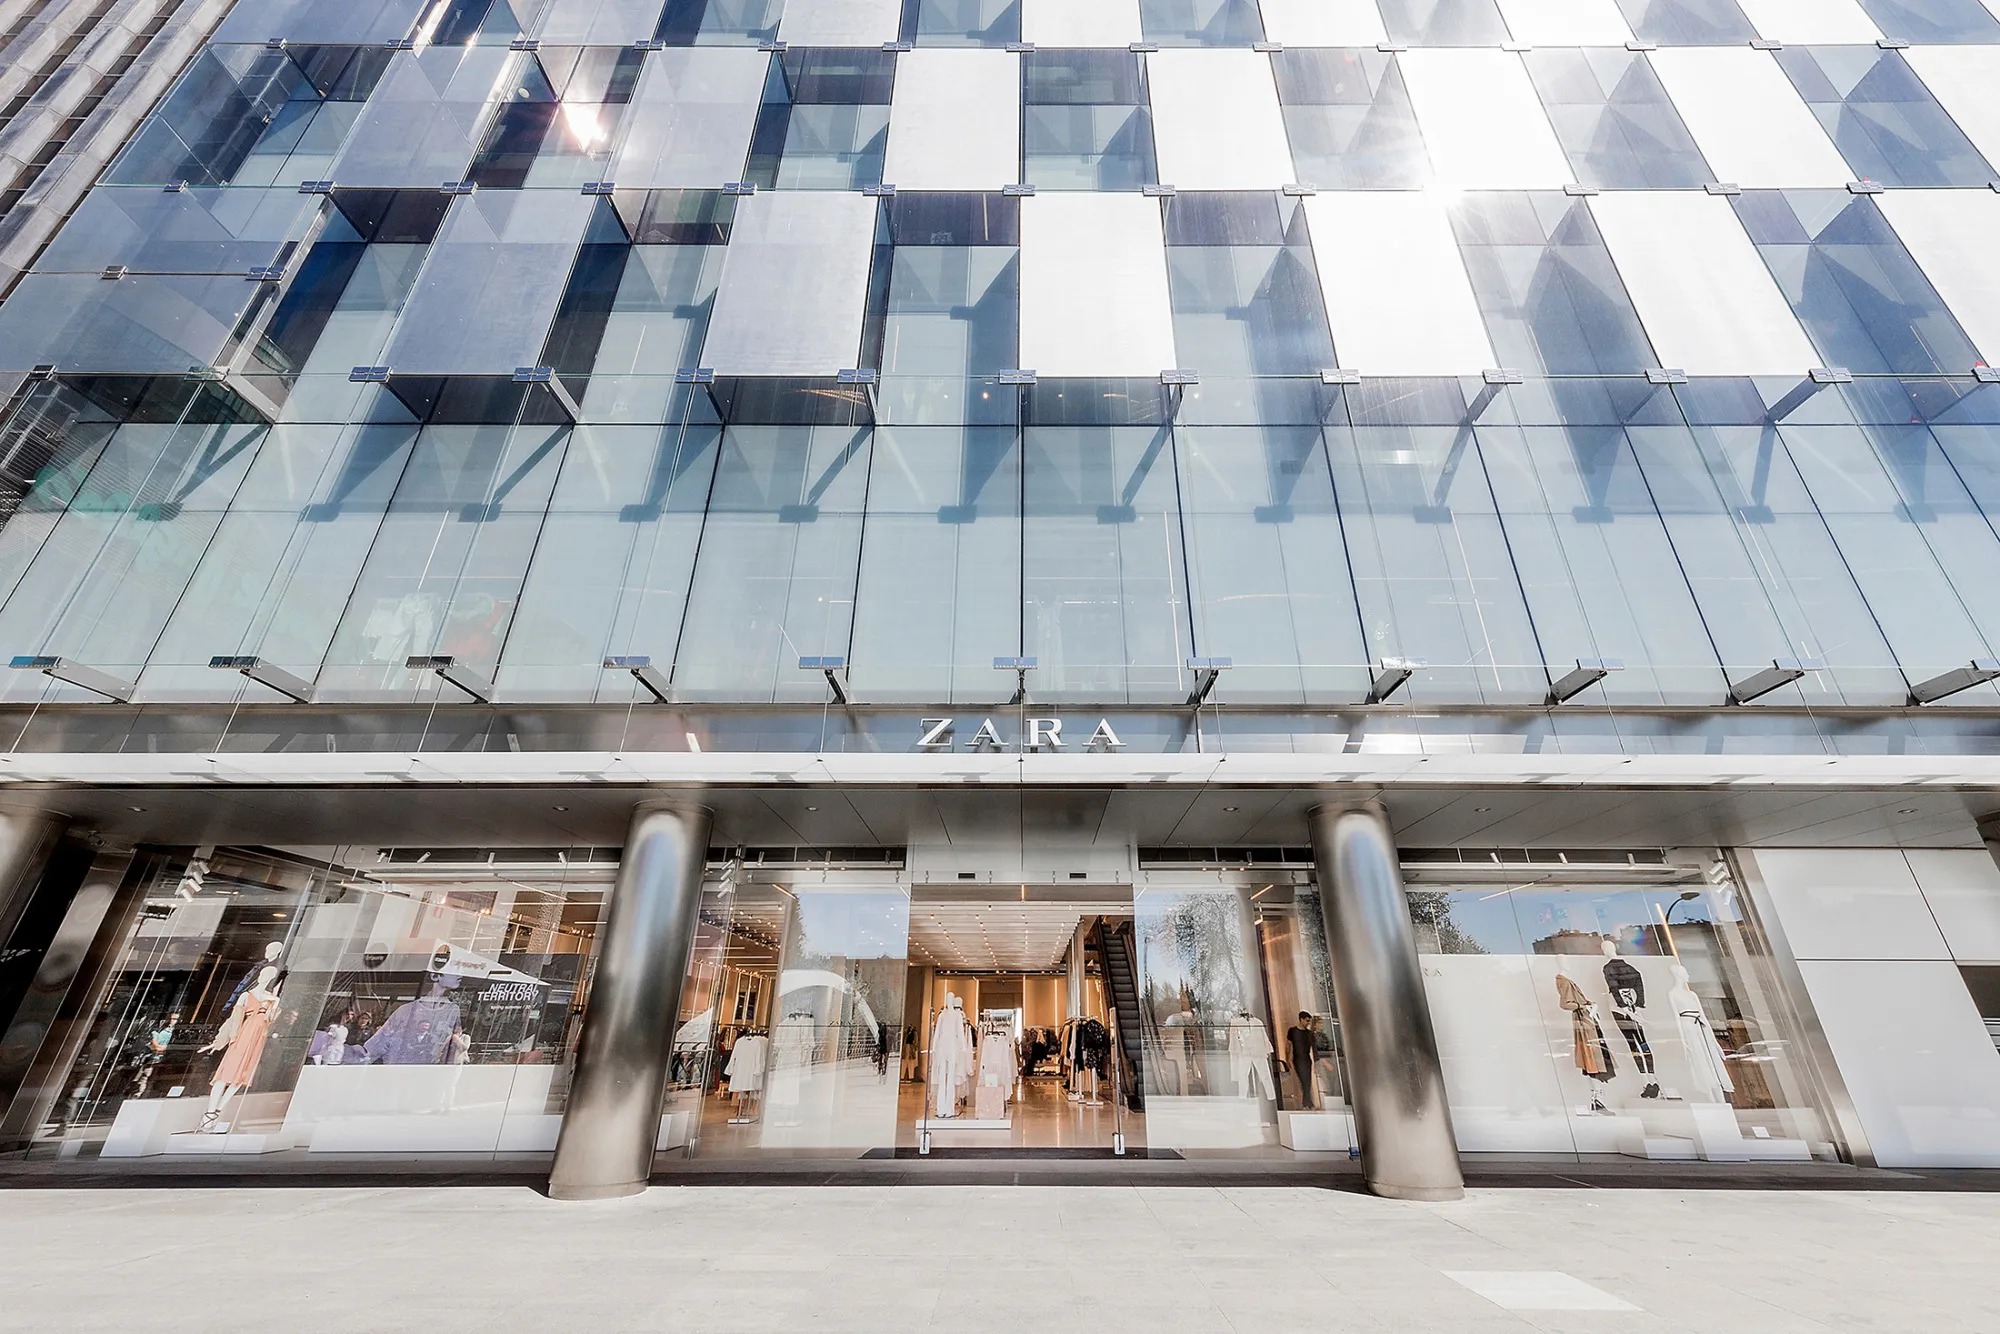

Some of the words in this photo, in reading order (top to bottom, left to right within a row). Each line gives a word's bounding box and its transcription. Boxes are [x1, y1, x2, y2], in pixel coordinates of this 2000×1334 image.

[917, 717, 1127, 746] ZARA
[489, 983, 539, 992] NEUTRAL
[477, 991, 539, 1001] TERRITORY
